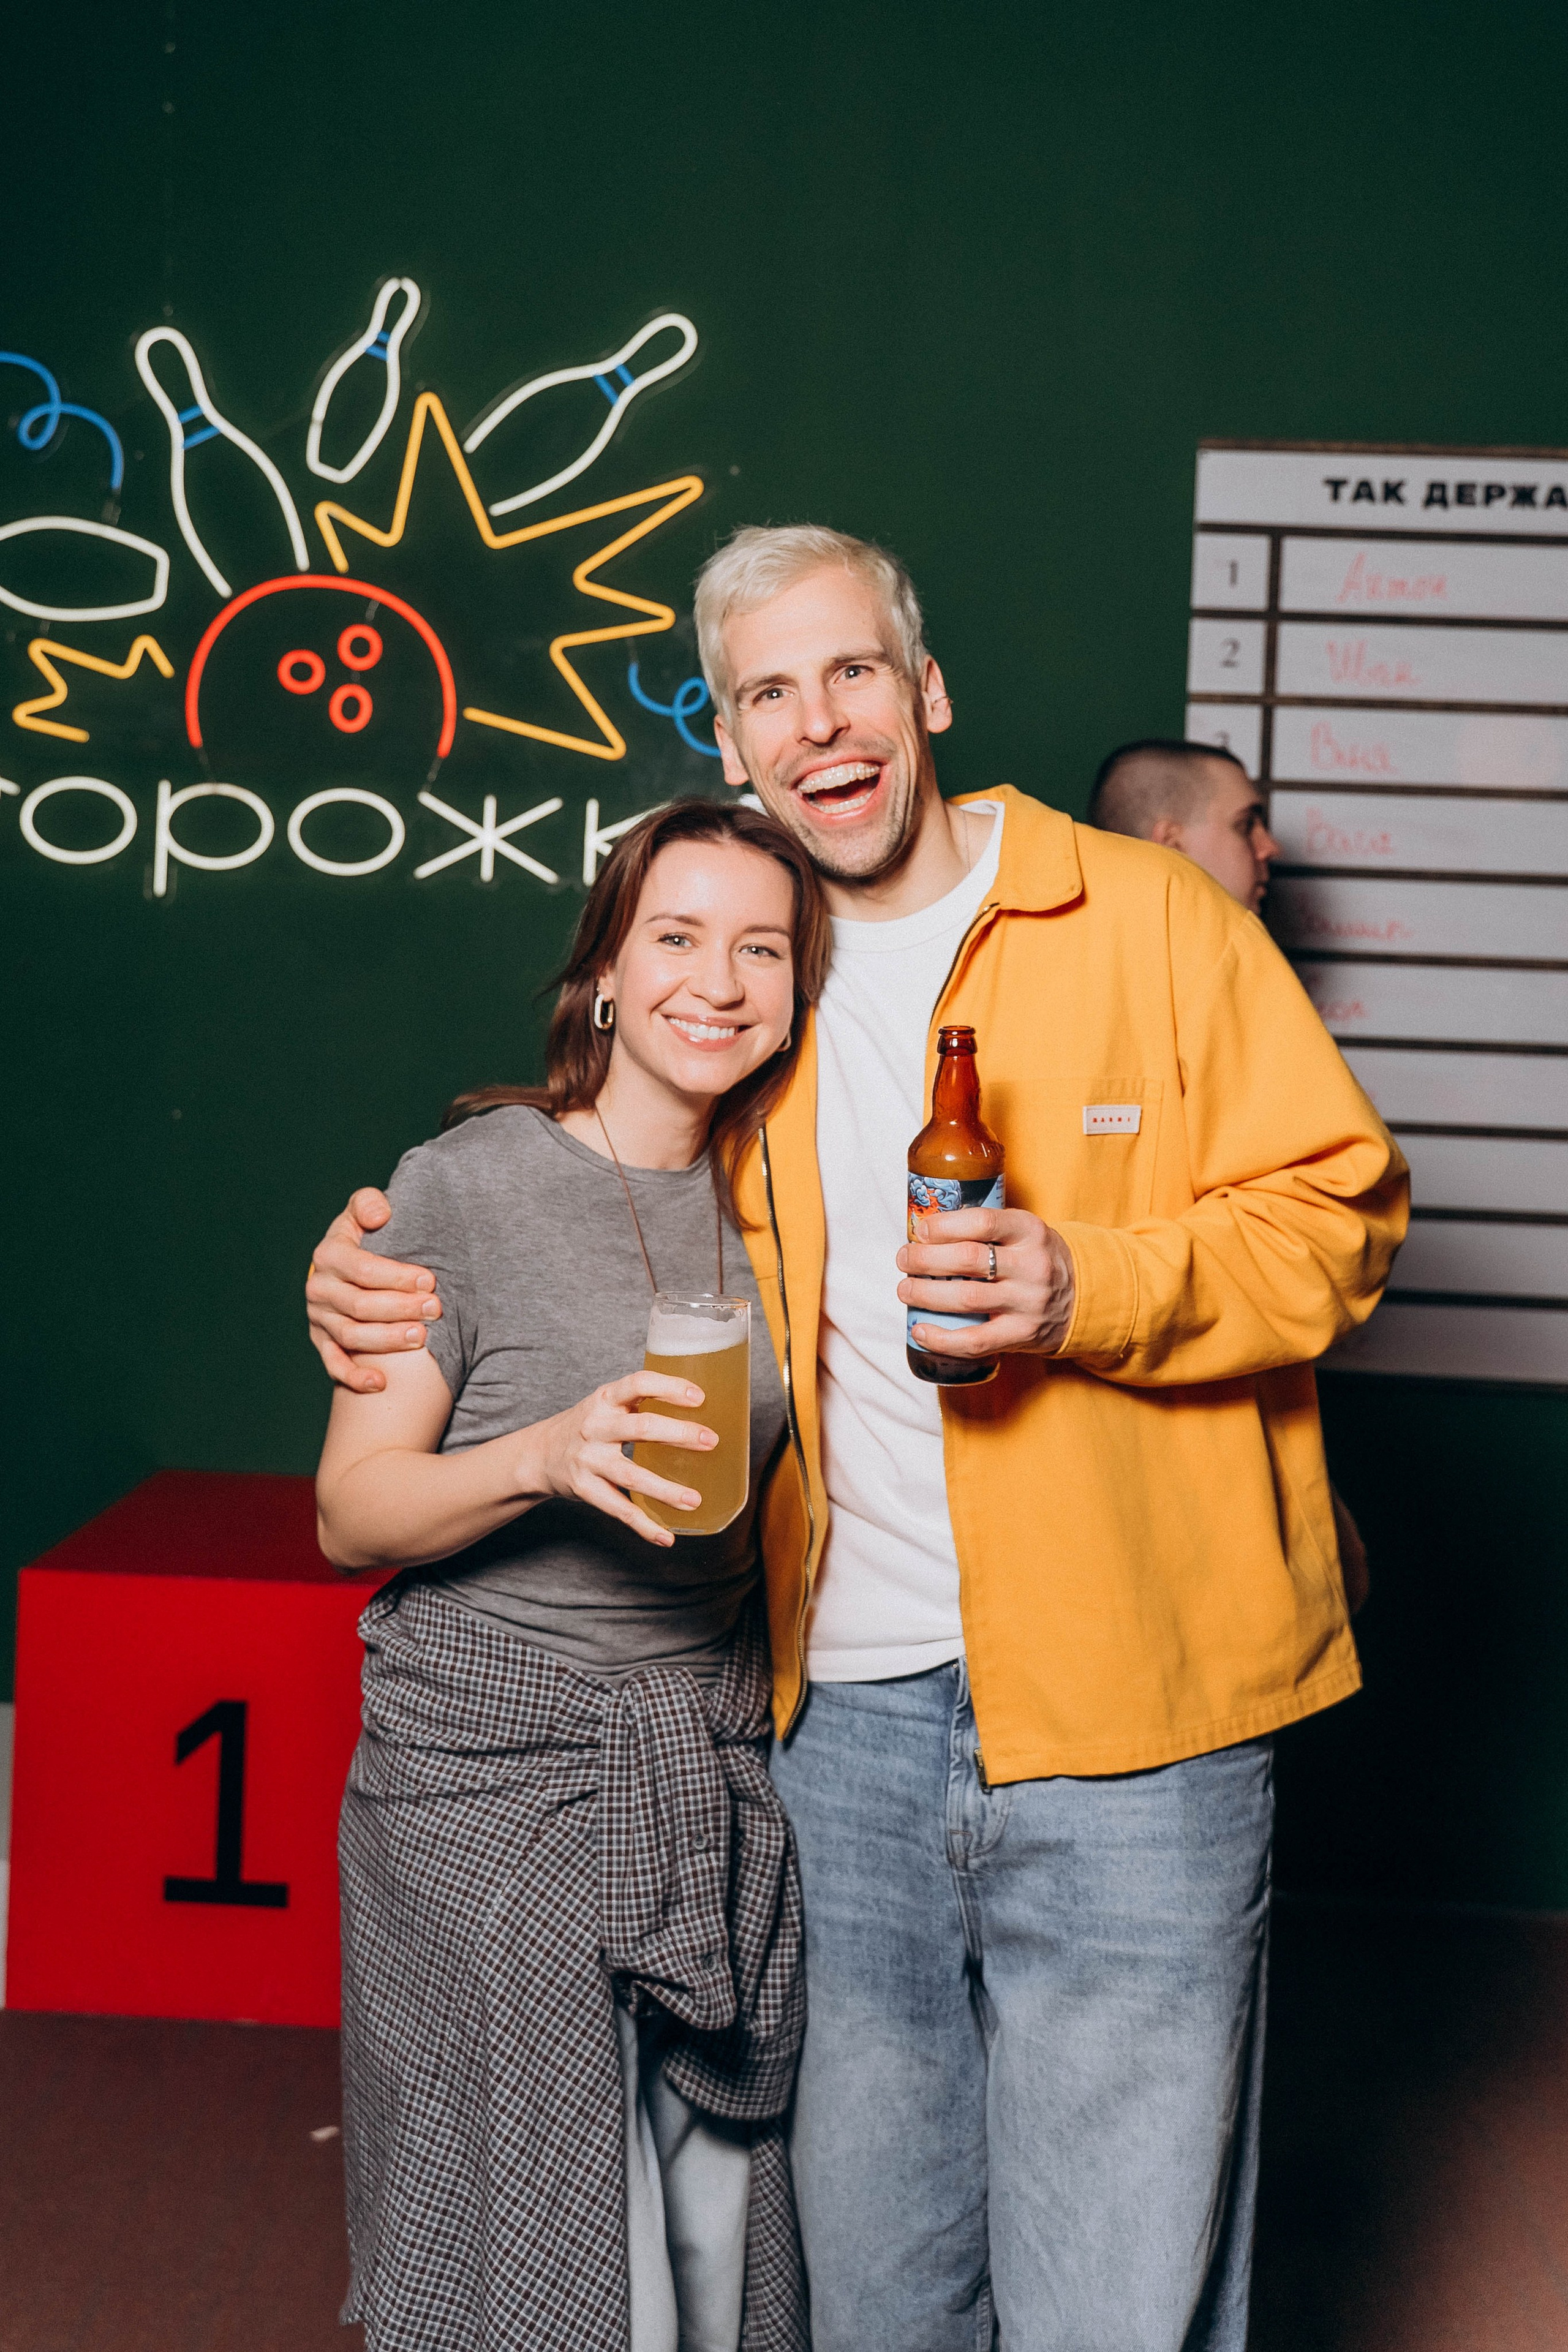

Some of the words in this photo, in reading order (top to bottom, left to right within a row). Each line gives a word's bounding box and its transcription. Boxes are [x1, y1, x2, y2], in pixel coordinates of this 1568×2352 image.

[1324, 478, 1406, 505] ТАК
[1423, 481, 1568, 510] ДЕРЖА
[1220, 638, 1240, 668] 2
[0, 776, 671, 898] орожк
[164, 1699, 288, 1908] 1
